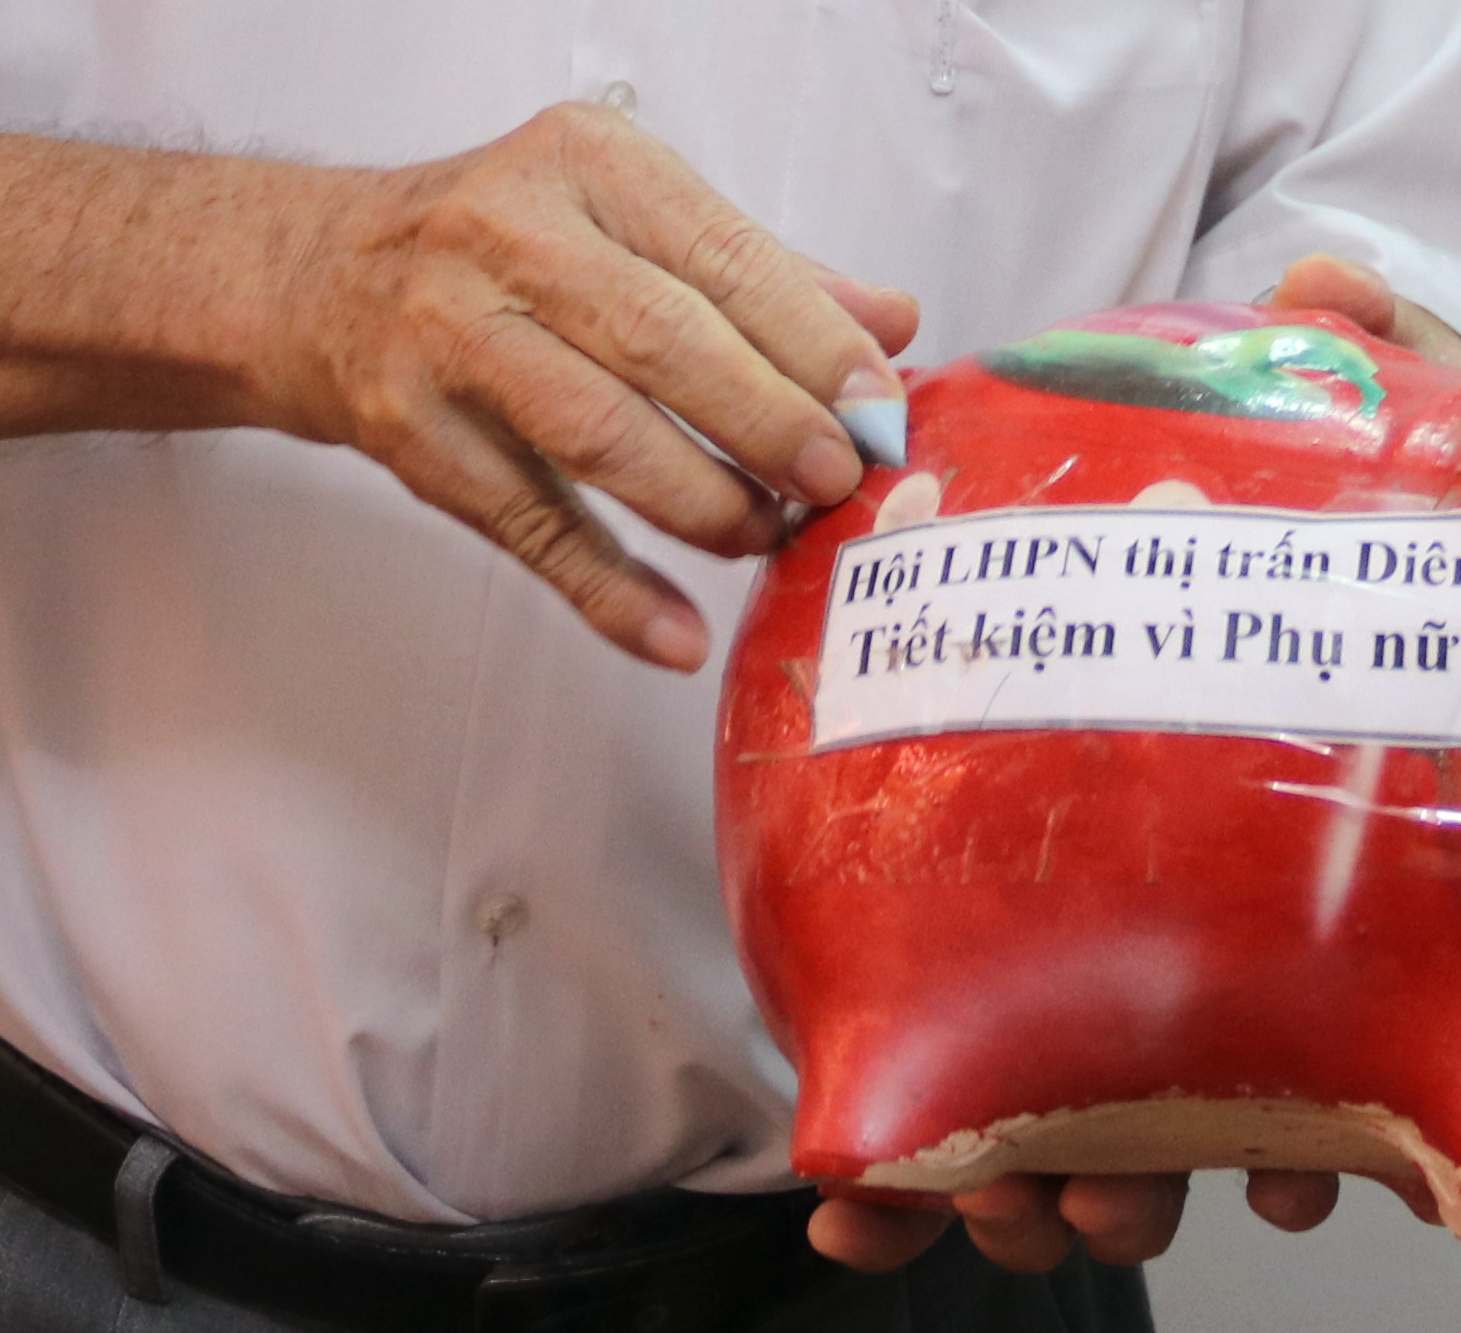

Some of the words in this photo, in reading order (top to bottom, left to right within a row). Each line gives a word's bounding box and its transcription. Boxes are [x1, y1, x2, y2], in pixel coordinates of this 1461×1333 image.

[843, 550, 924, 606] Hội
[939, 535, 1105, 586] LHPN
[1124, 536, 1197, 589] thị
[1217, 529, 1331, 582] trấn
[850, 603, 950, 678] Tiết
[971, 607, 1117, 672] kiệm
[1145, 610, 1195, 661] vì
[1222, 610, 1344, 682] Phụ
[1371, 620, 1459, 671] nữ
